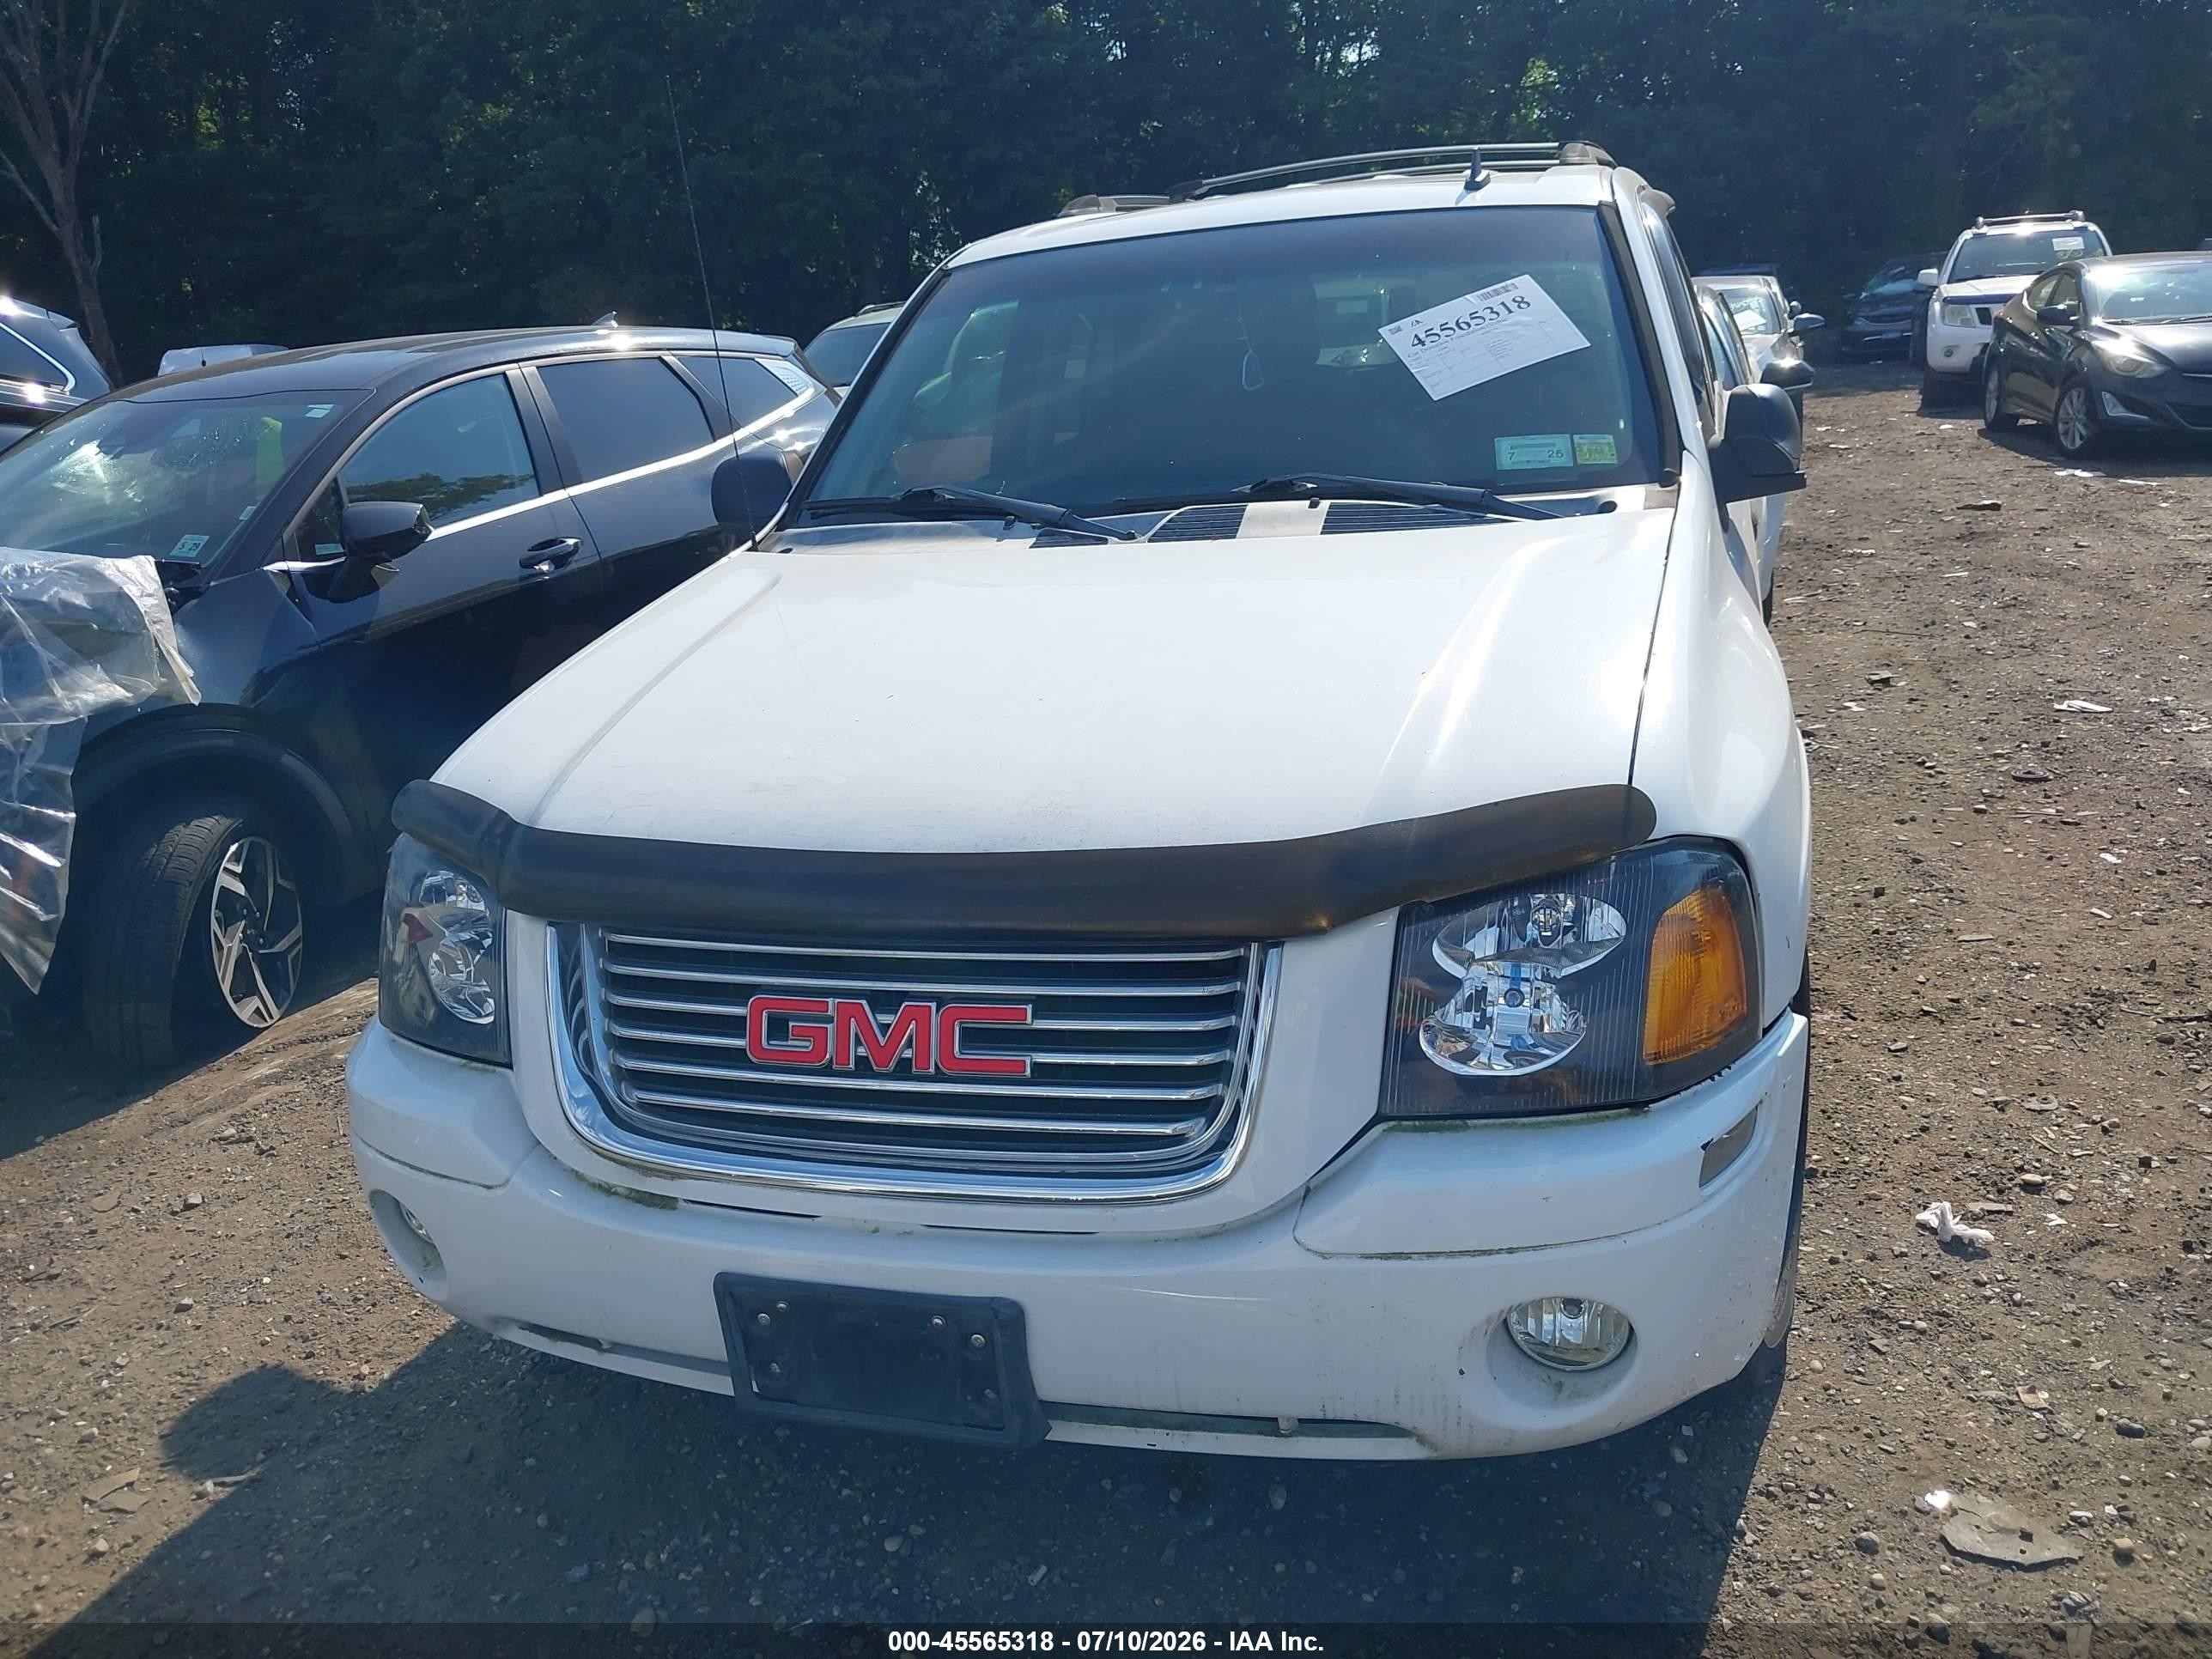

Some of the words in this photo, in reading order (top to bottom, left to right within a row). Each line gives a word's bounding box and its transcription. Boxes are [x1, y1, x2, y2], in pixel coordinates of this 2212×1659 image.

[1411, 295, 1531, 348] 45565318
[1508, 452, 1516, 460] 7
[1547, 449, 1564, 459] 25
[747, 995, 1032, 1078] GMC
